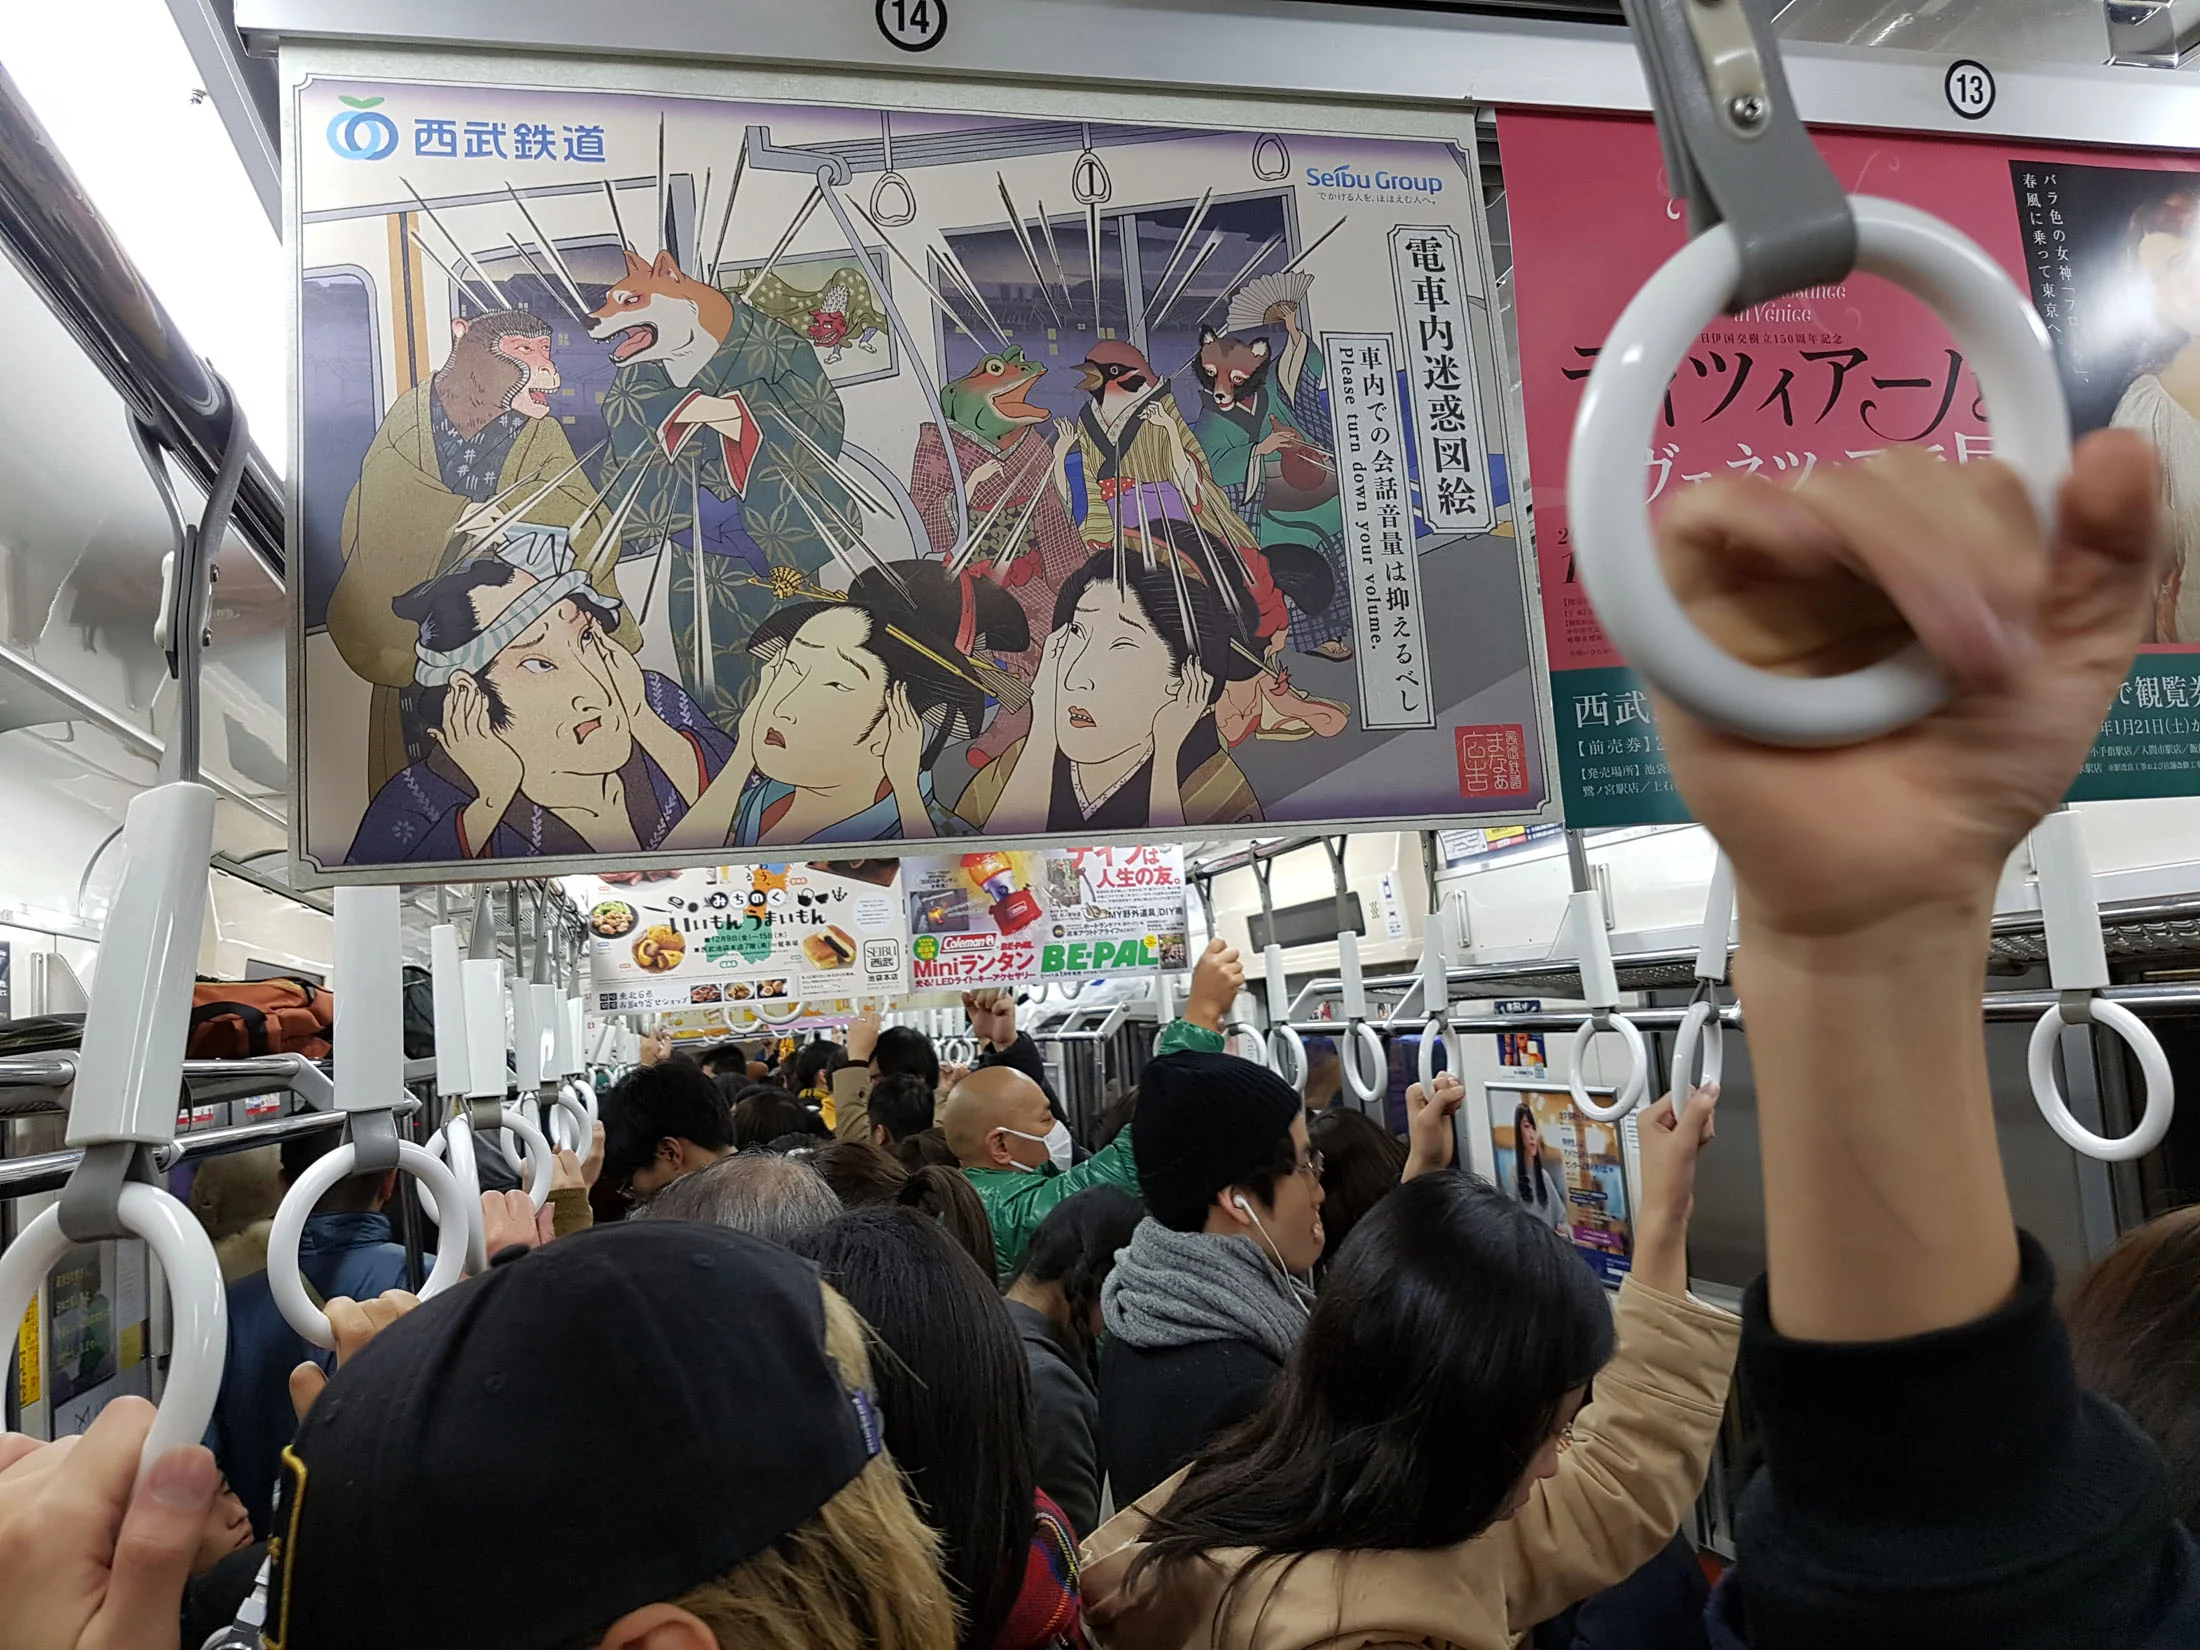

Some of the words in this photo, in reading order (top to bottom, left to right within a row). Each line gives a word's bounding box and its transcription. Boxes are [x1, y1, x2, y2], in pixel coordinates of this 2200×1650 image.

[891, 0, 930, 34] 14
[1956, 73, 1984, 105] 13
[414, 118, 606, 163] 西武鉄道
[1305, 164, 1371, 190] Seibu
[1375, 171, 1443, 194] Group
[1317, 191, 1438, 206] でかける人を、ほほえむ人へ。
[1753, 302, 1812, 323] Venice
[1338, 347, 1358, 405] Please
[1405, 236, 1477, 516] 電車内迷惑図絵
[1346, 412, 1362, 453] turn
[1352, 461, 1369, 512] down
[1355, 519, 1373, 565] your
[1358, 346, 1421, 713] 車内での会話音量は抑えるべし
[1363, 572, 1382, 651] volume.
[1096, 866, 1181, 889] 人生の友。
[711, 890, 783, 908] みちのく
[867, 946, 897, 958] SEIBU
[943, 936, 985, 950] Coleman
[867, 973, 899, 982] 池袋本店
[870, 957, 895, 968] 西武
[913, 952, 1035, 979] Miniランタン
